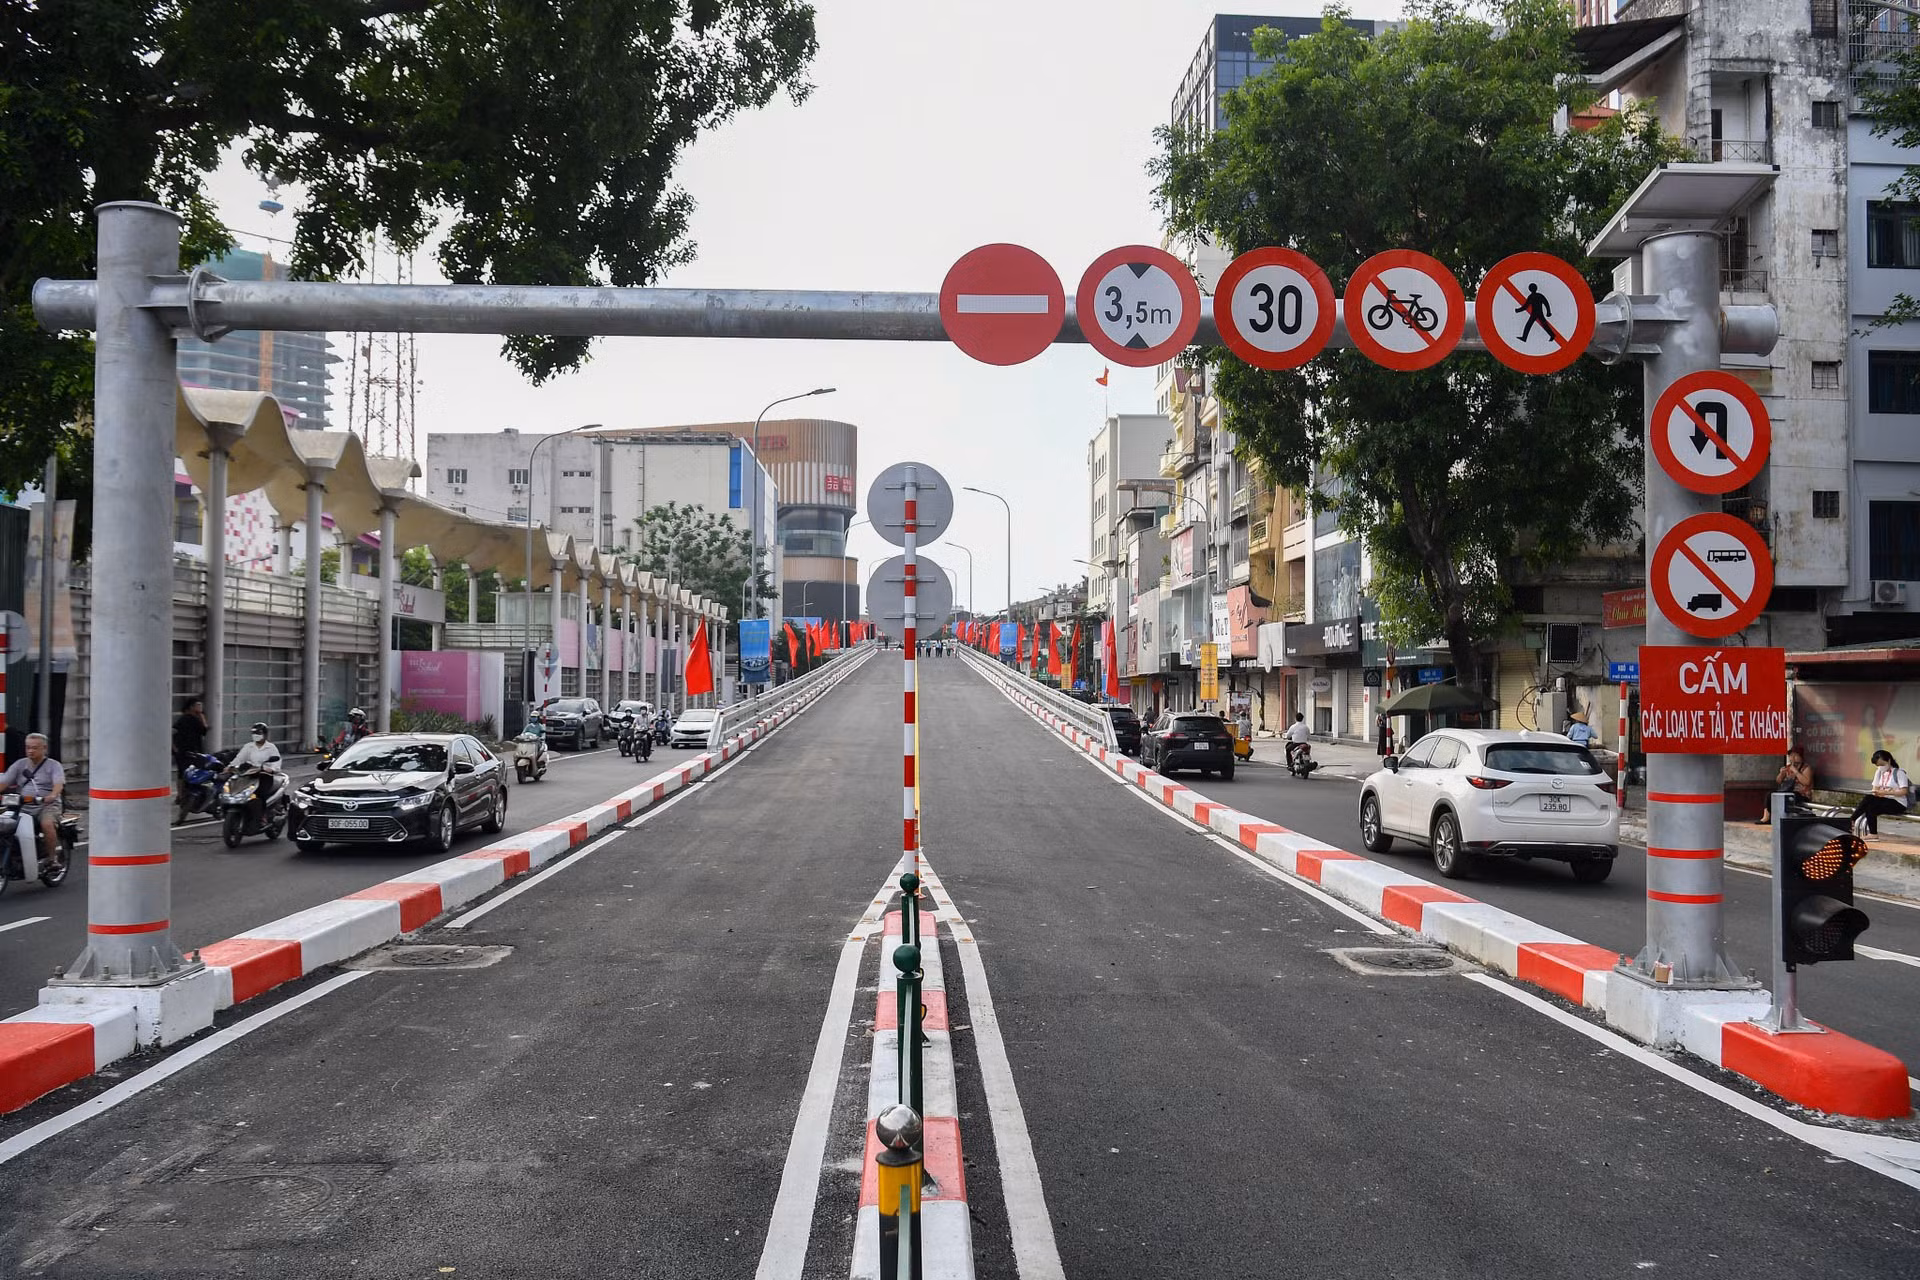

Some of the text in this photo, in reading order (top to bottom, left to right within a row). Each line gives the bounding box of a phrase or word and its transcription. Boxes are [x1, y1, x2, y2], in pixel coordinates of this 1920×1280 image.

[1104, 286, 1172, 329] 3,5m
[1249, 283, 1303, 335] 30
[1679, 651, 1748, 694] CẤM
[1641, 701, 1786, 743] CÁC LOẠI XE TẢI, XE KHÁCH
